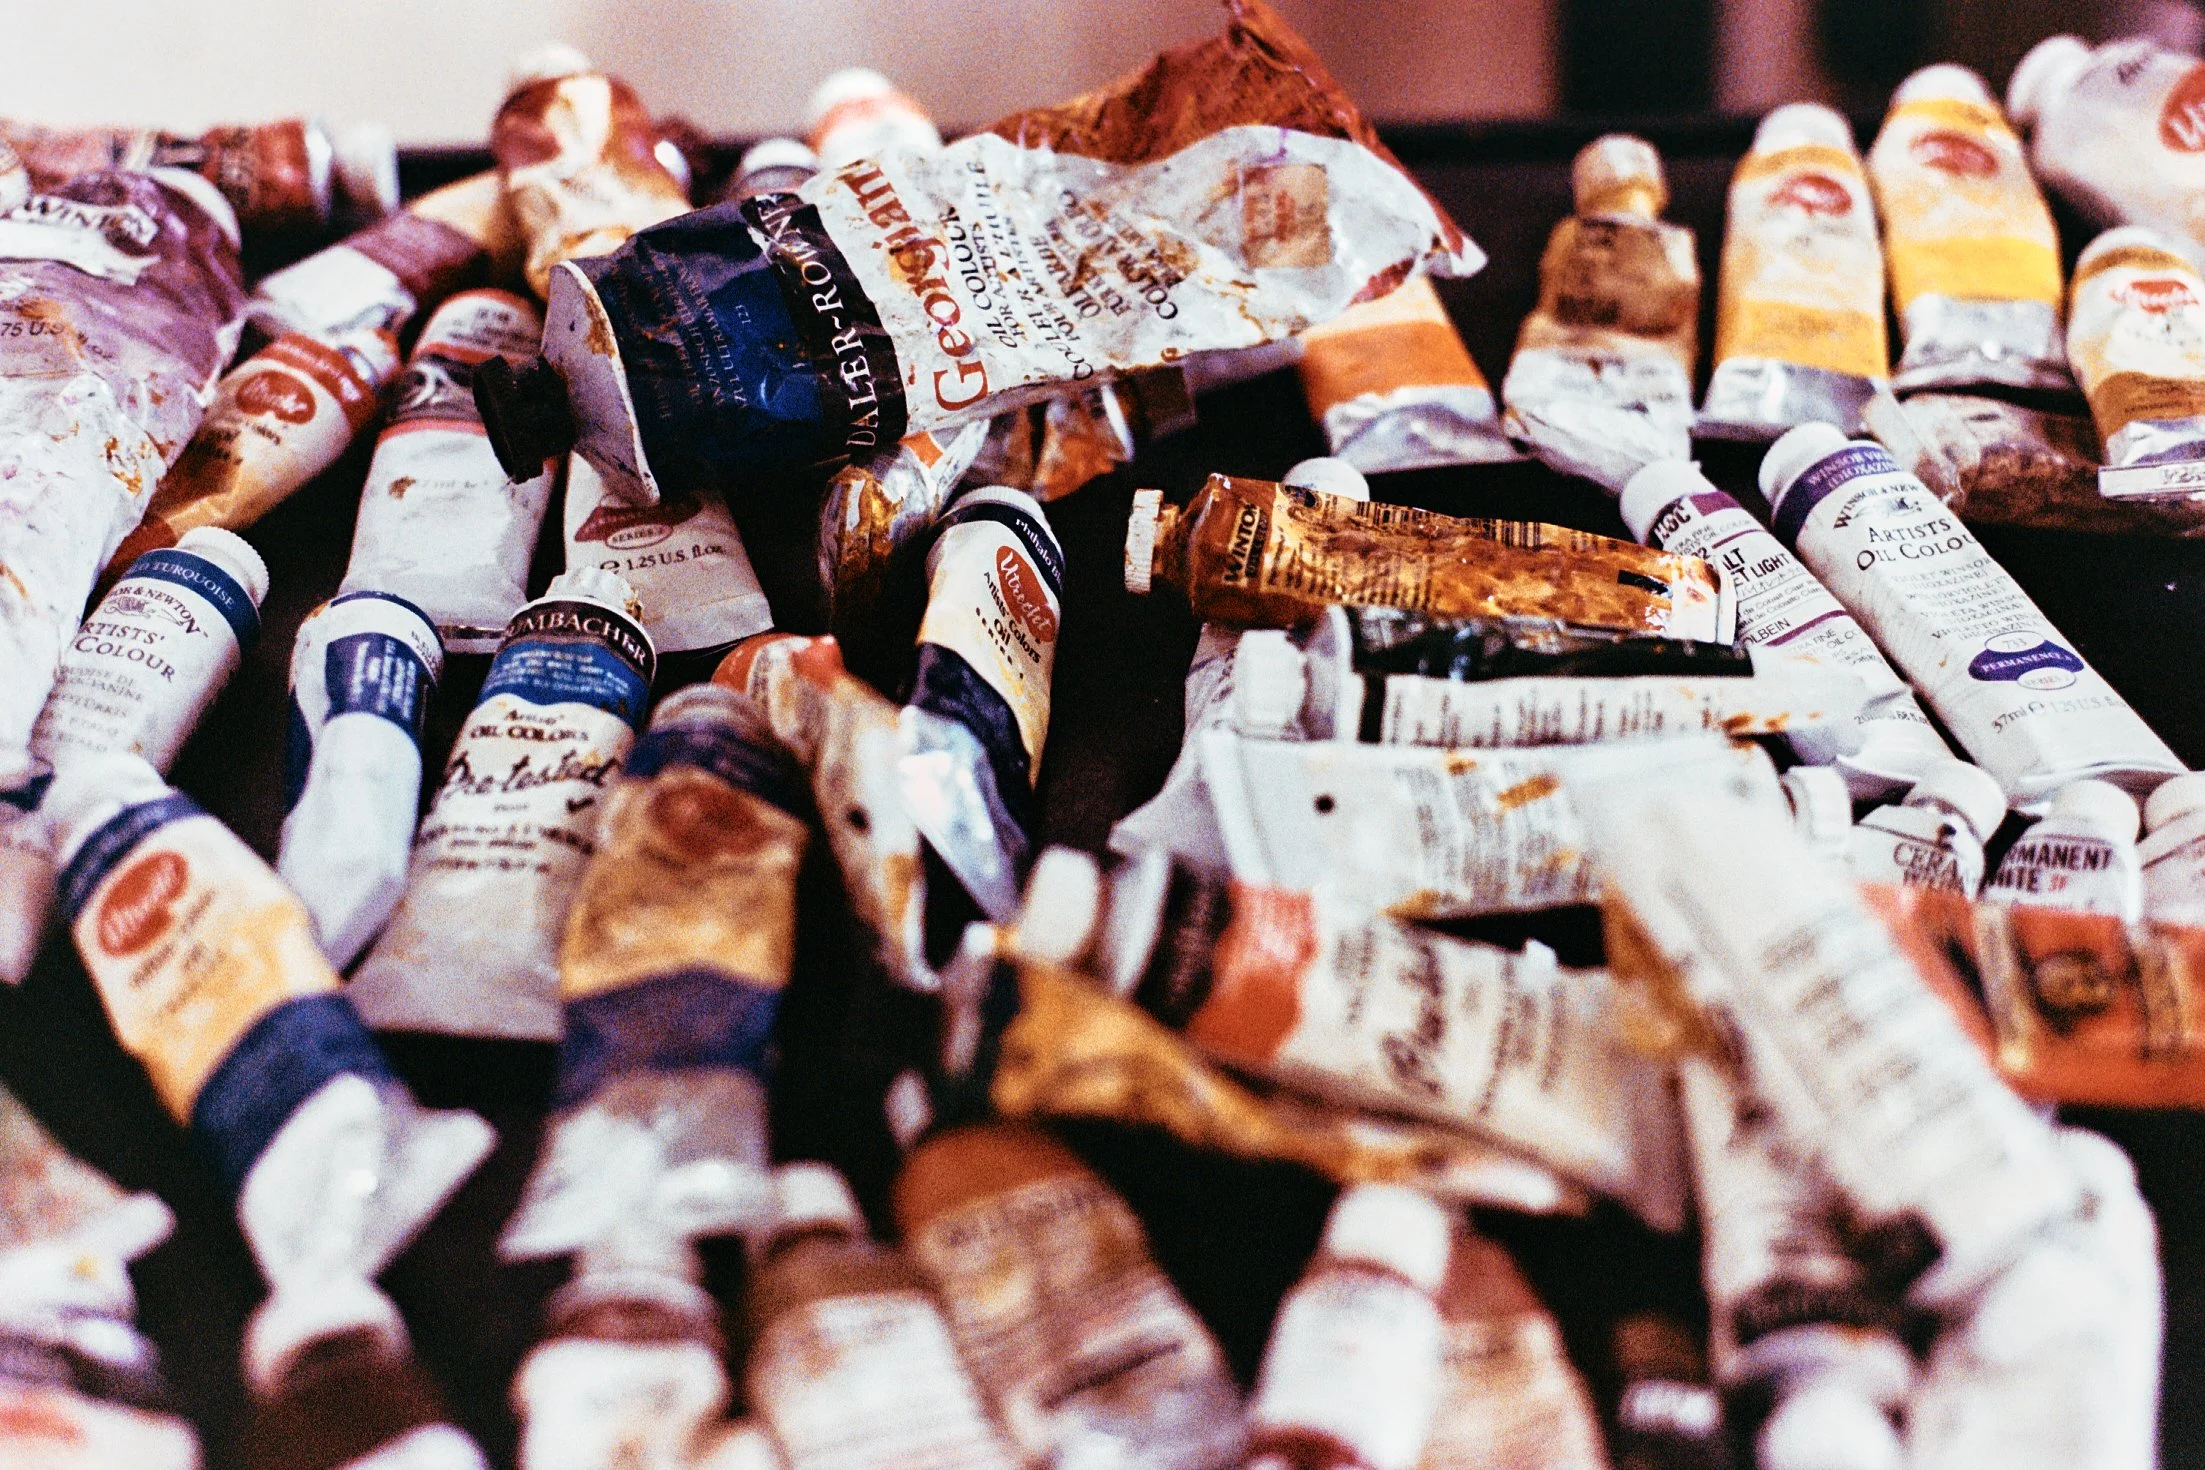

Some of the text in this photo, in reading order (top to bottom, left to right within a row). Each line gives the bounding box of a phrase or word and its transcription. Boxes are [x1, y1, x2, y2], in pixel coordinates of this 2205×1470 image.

[836, 165, 989, 412] Georgian
[938, 206, 1018, 348] OIL COLOUR
[736, 303, 752, 325] 123
[999, 304, 1025, 336] FOR
[1016, 518, 1052, 566] Phthalo
[626, 555, 656, 570] 1.25
[1750, 553, 1790, 578] LIGHT
[1856, 550, 1896, 571] OIL
[153, 561, 236, 611] TURQUOISE
[1000, 550, 1051, 632] Utrecht
[147, 588, 202, 636] NEWTON
[79, 621, 166, 646] RTISTS'
[506, 611, 647, 667] UMBACHER
[994, 618, 1010, 646] Oil
[1008, 619, 1041, 664] Colors
[1742, 617, 1791, 649] OLBEIN
[75, 635, 176, 684] COLOUR
[470, 725, 503, 739] OIL
[2004, 843, 2113, 870] RMANENT
